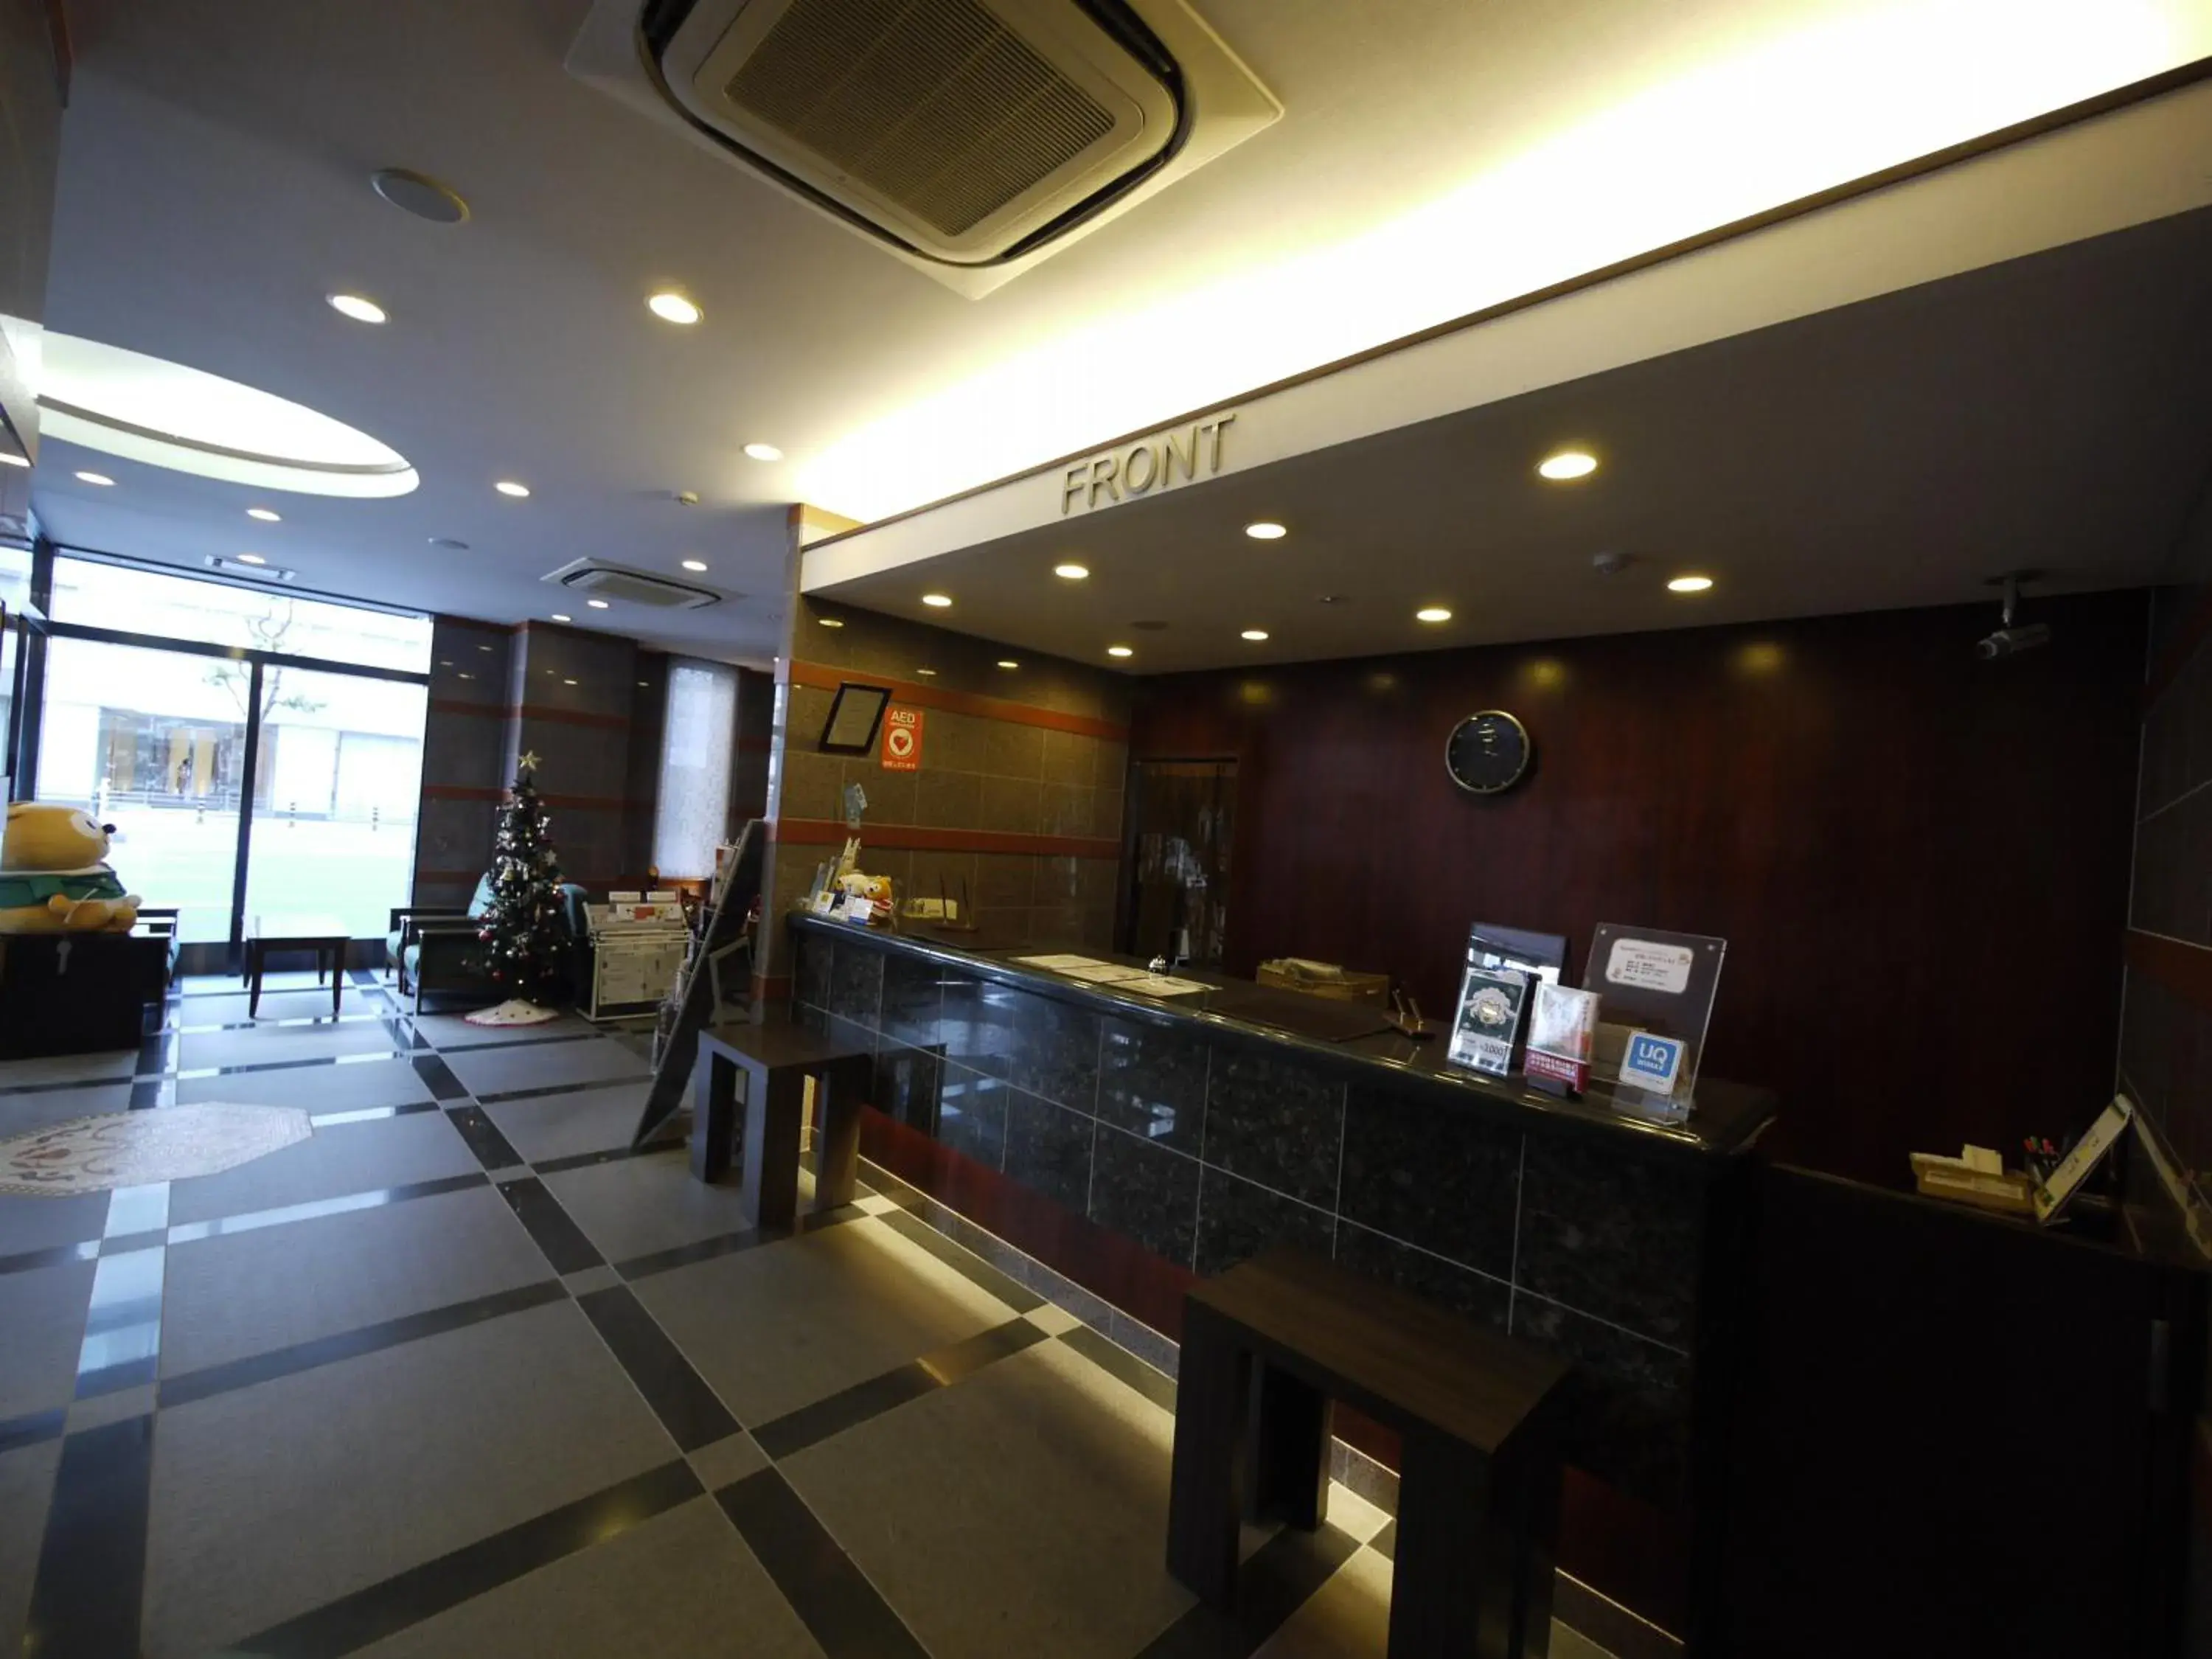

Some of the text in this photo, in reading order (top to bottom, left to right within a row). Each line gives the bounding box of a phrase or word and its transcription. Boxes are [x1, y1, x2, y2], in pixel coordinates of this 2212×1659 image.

[1062, 413, 1237, 515] FRONT
[890, 709, 915, 723] AED
[1638, 1042, 1669, 1064] UQ
